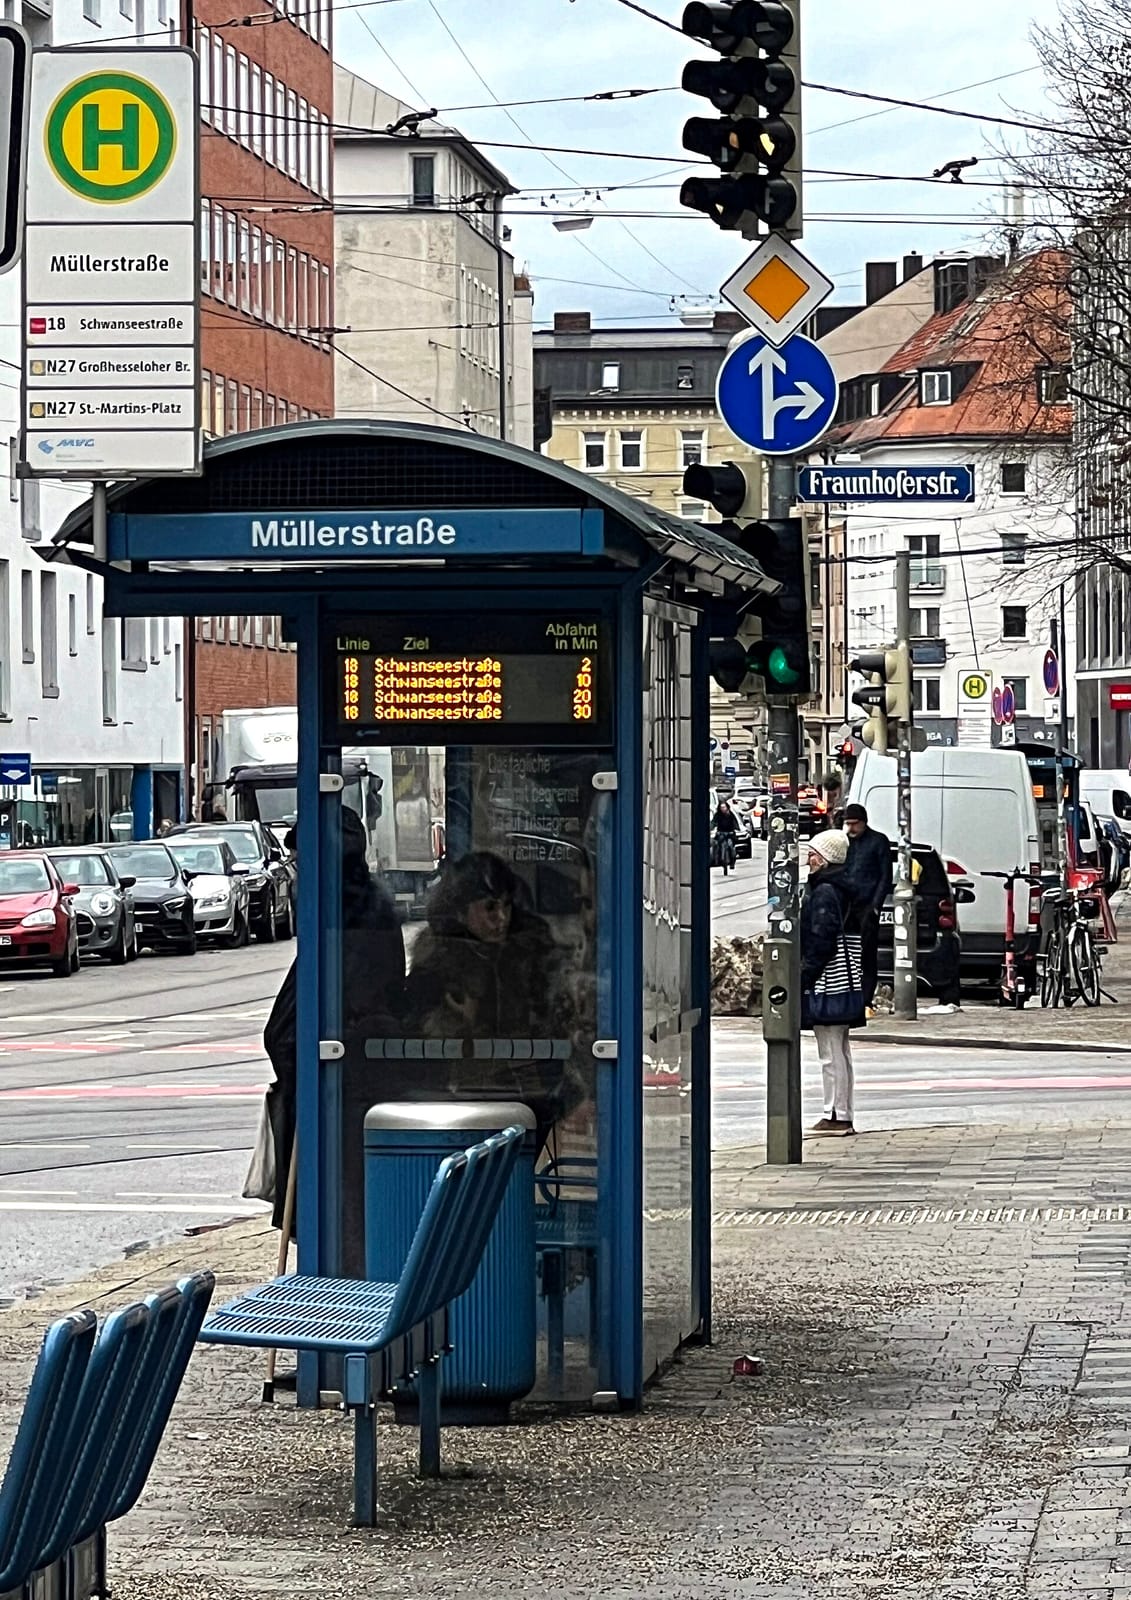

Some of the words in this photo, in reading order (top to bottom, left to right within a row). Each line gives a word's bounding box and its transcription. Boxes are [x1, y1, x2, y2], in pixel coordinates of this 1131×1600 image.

[82, 103, 139, 171] H
[50, 254, 169, 272] Müllerstraße
[47, 317, 66, 331] 18
[79, 317, 184, 331] Schwanseestraße
[46, 359, 76, 373] N27
[78, 360, 171, 373] Großhesseloher
[175, 360, 191, 373] Br.
[46, 401, 76, 415] N27
[79, 402, 182, 415] St.-Martins-Platz
[809, 469, 960, 498] Fraunhoferstr.
[251, 517, 457, 547] Müllerstraße
[545, 622, 598, 637] Abfahrt
[336, 637, 371, 651] Linie
[403, 637, 430, 651] Ziel
[555, 637, 568, 650] in
[572, 637, 598, 650] Min
[344, 657, 359, 673] 18
[374, 657, 502, 673] Schwanseestraße
[581, 657, 592, 673] 2
[344, 673, 359, 689] 18
[374, 673, 502, 689] Schwanseestraße
[576, 673, 592, 689] 10
[344, 689, 359, 704] 18
[374, 689, 502, 704] Schwanseestraße
[573, 689, 592, 704] 20
[344, 705, 359, 720] 18
[374, 705, 502, 720] Schwanseestraße
[573, 705, 592, 720] 30
